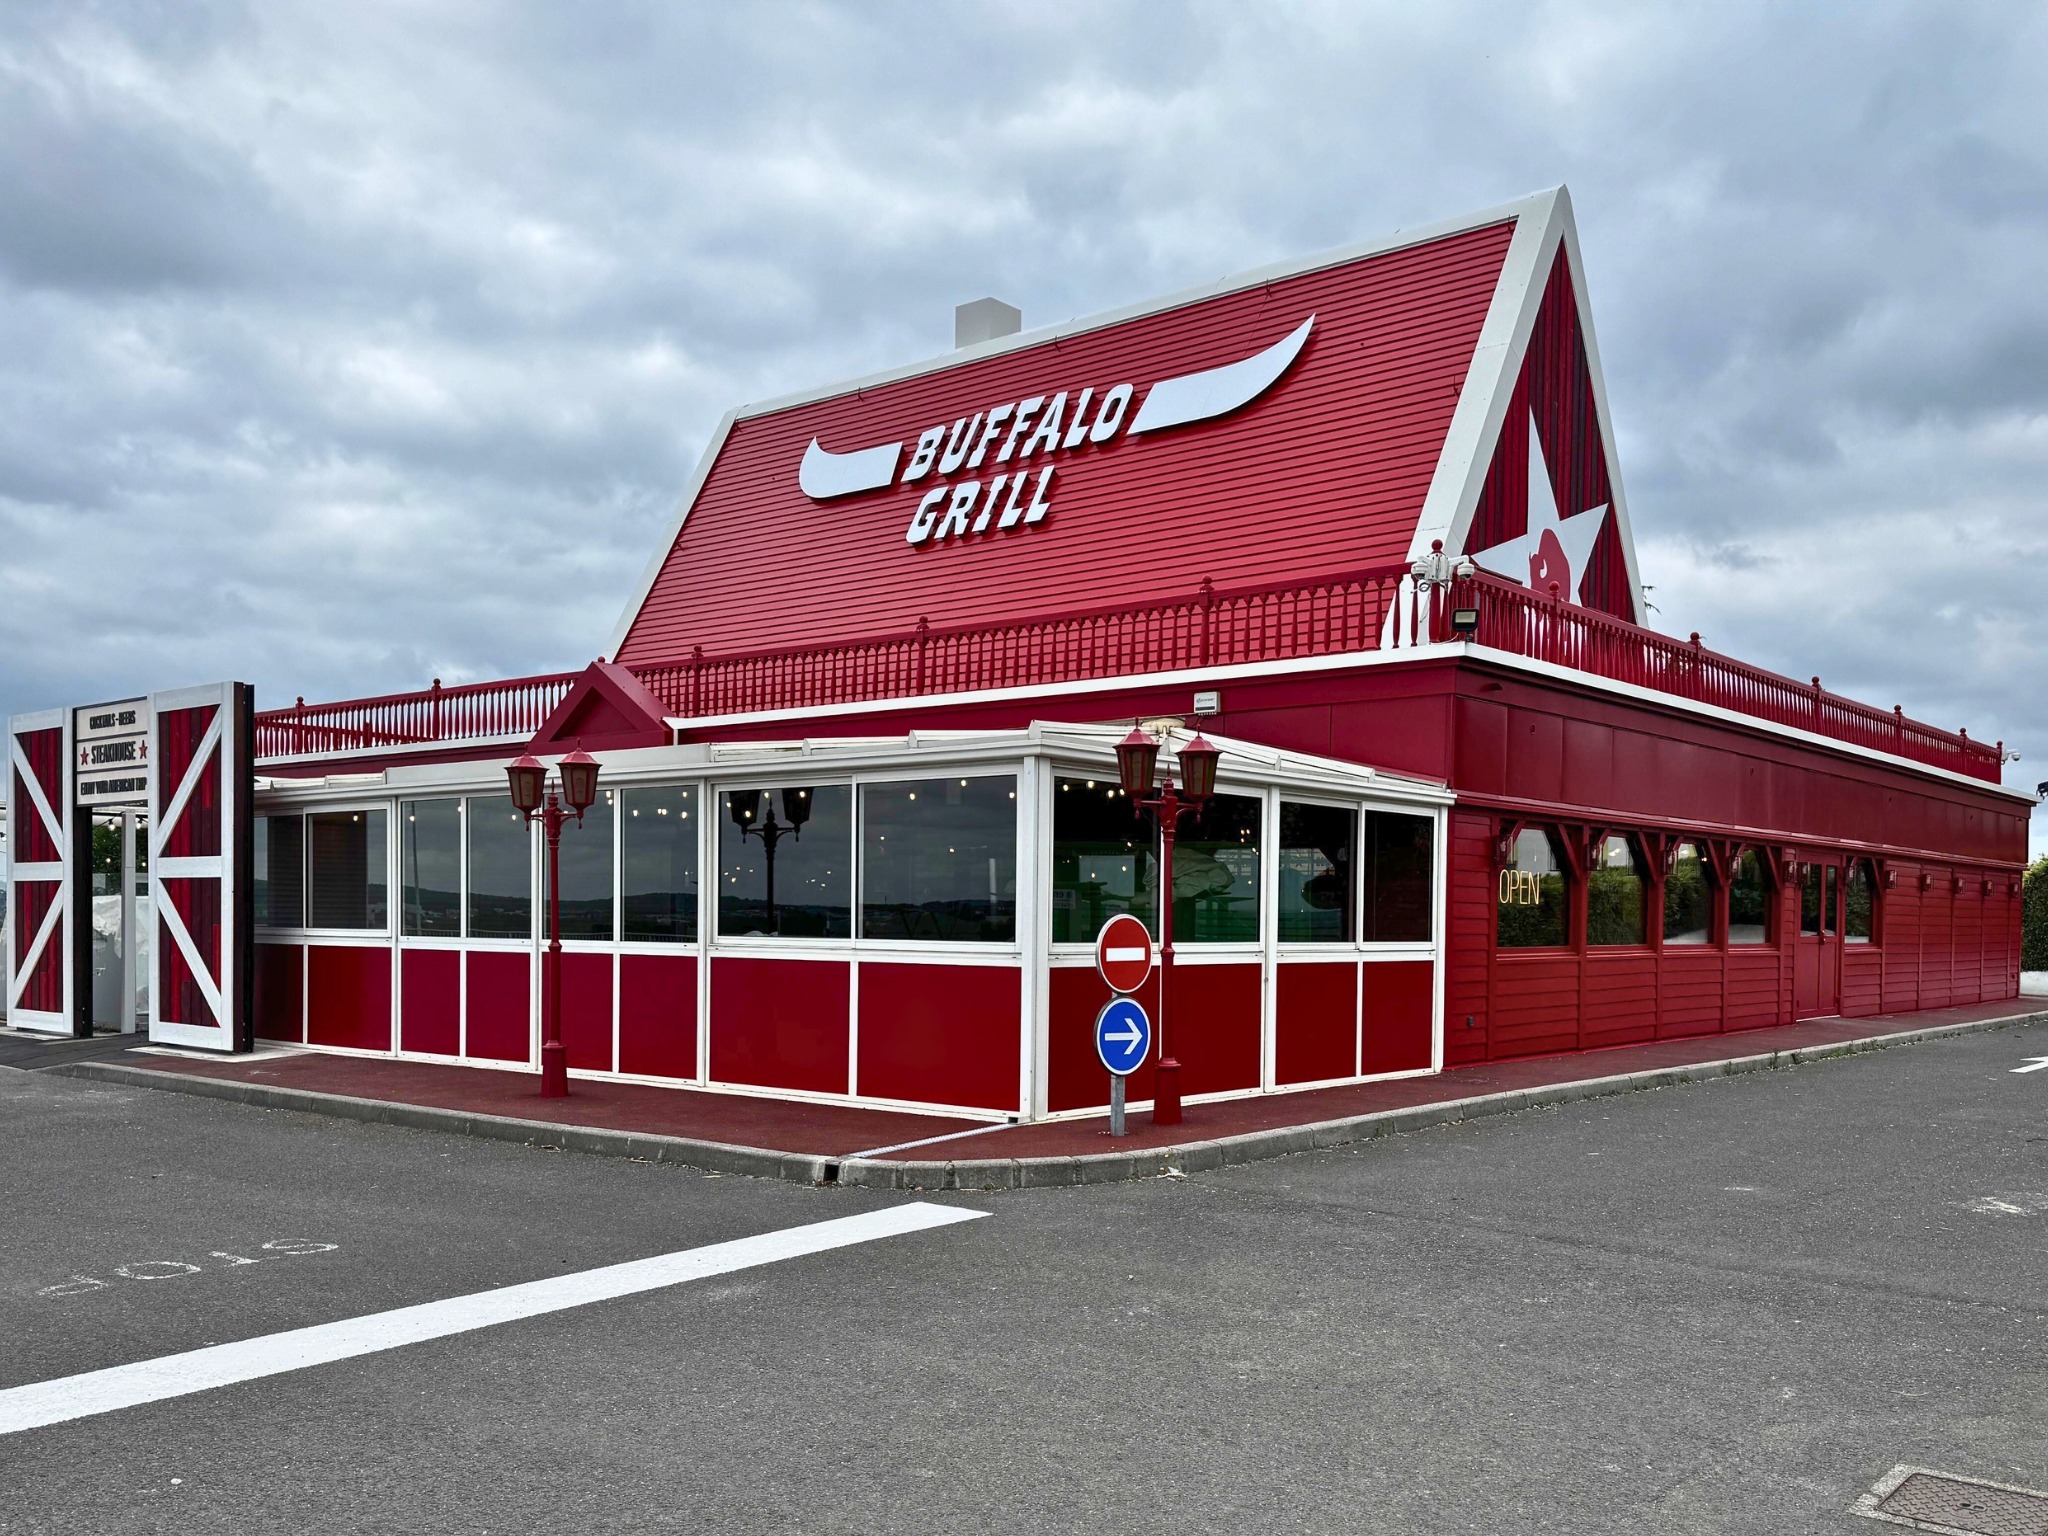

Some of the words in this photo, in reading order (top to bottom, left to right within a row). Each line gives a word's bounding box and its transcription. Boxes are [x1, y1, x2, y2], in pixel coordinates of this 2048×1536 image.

[901, 383, 1134, 482] BUFFALO
[906, 465, 1056, 544] GRILL
[90, 713, 115, 730] COCKTAILS
[119, 710, 136, 726] BEERS
[91, 741, 136, 765] STEAKHOUSE
[80, 782, 96, 796] ENJOY
[96, 780, 108, 794] YOUR
[109, 778, 134, 793] AMERICAN
[135, 777, 147, 790] TRIP
[1499, 869, 1540, 905] OPEN
